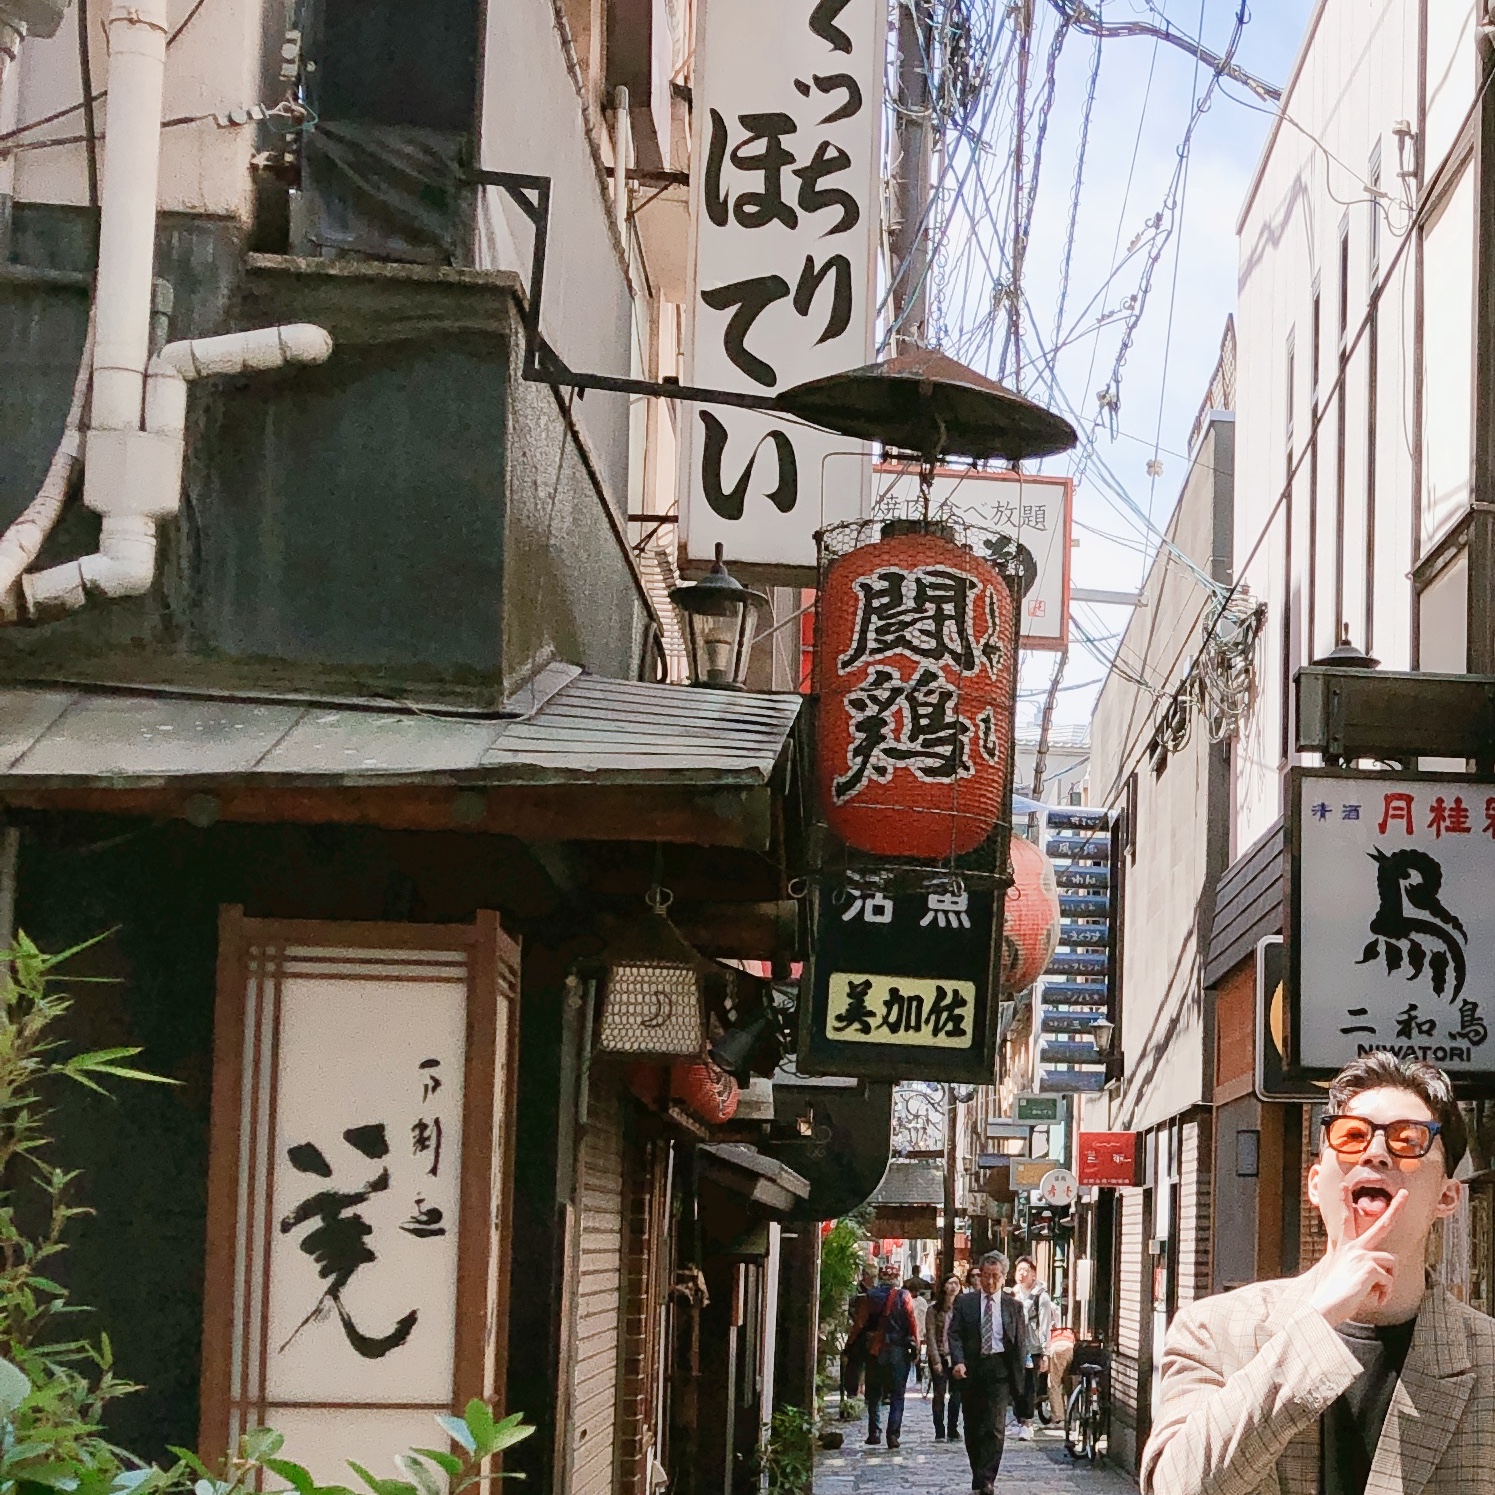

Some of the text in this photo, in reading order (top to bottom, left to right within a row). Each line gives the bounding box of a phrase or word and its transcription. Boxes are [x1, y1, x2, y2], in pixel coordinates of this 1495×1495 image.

[700, 107, 799, 521] ほてい
[872, 494, 1048, 532] 焼肉食べ放題
[832, 979, 969, 1038] 美加佐
[1339, 998, 1488, 1047] 二和鳥
